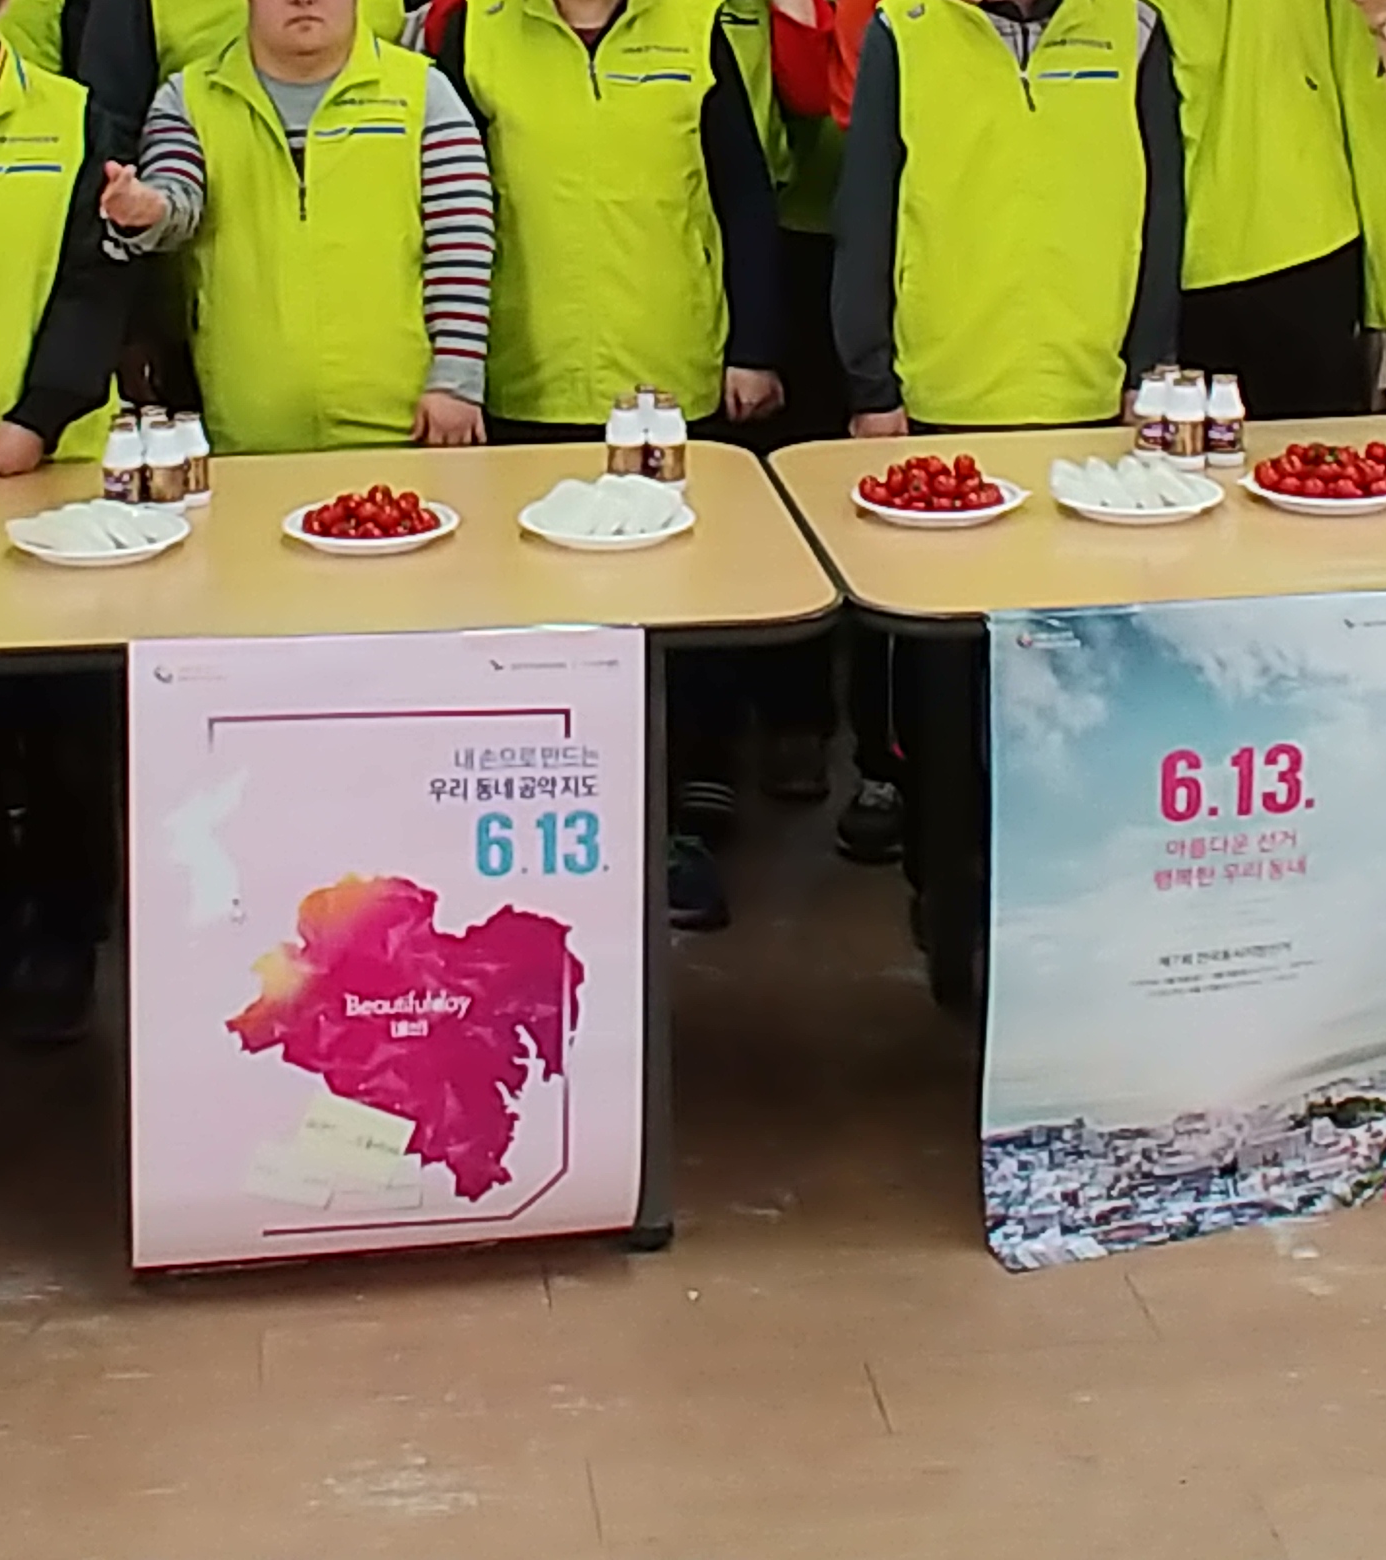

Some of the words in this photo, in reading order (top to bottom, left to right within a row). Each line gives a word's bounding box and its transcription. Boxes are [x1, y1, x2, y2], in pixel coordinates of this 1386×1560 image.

[455, 748, 475, 771] 내
[479, 747, 536, 771] 손으로
[541, 745, 599, 769] 만드는
[429, 777, 469, 802] 우리
[476, 777, 513, 801] 동네
[519, 775, 557, 799] 공약
[561, 774, 600, 798] 지도
[1166, 832, 1249, 859] 아름다운
[1258, 829, 1297, 853] 선거
[1224, 861, 1263, 884] 우리
